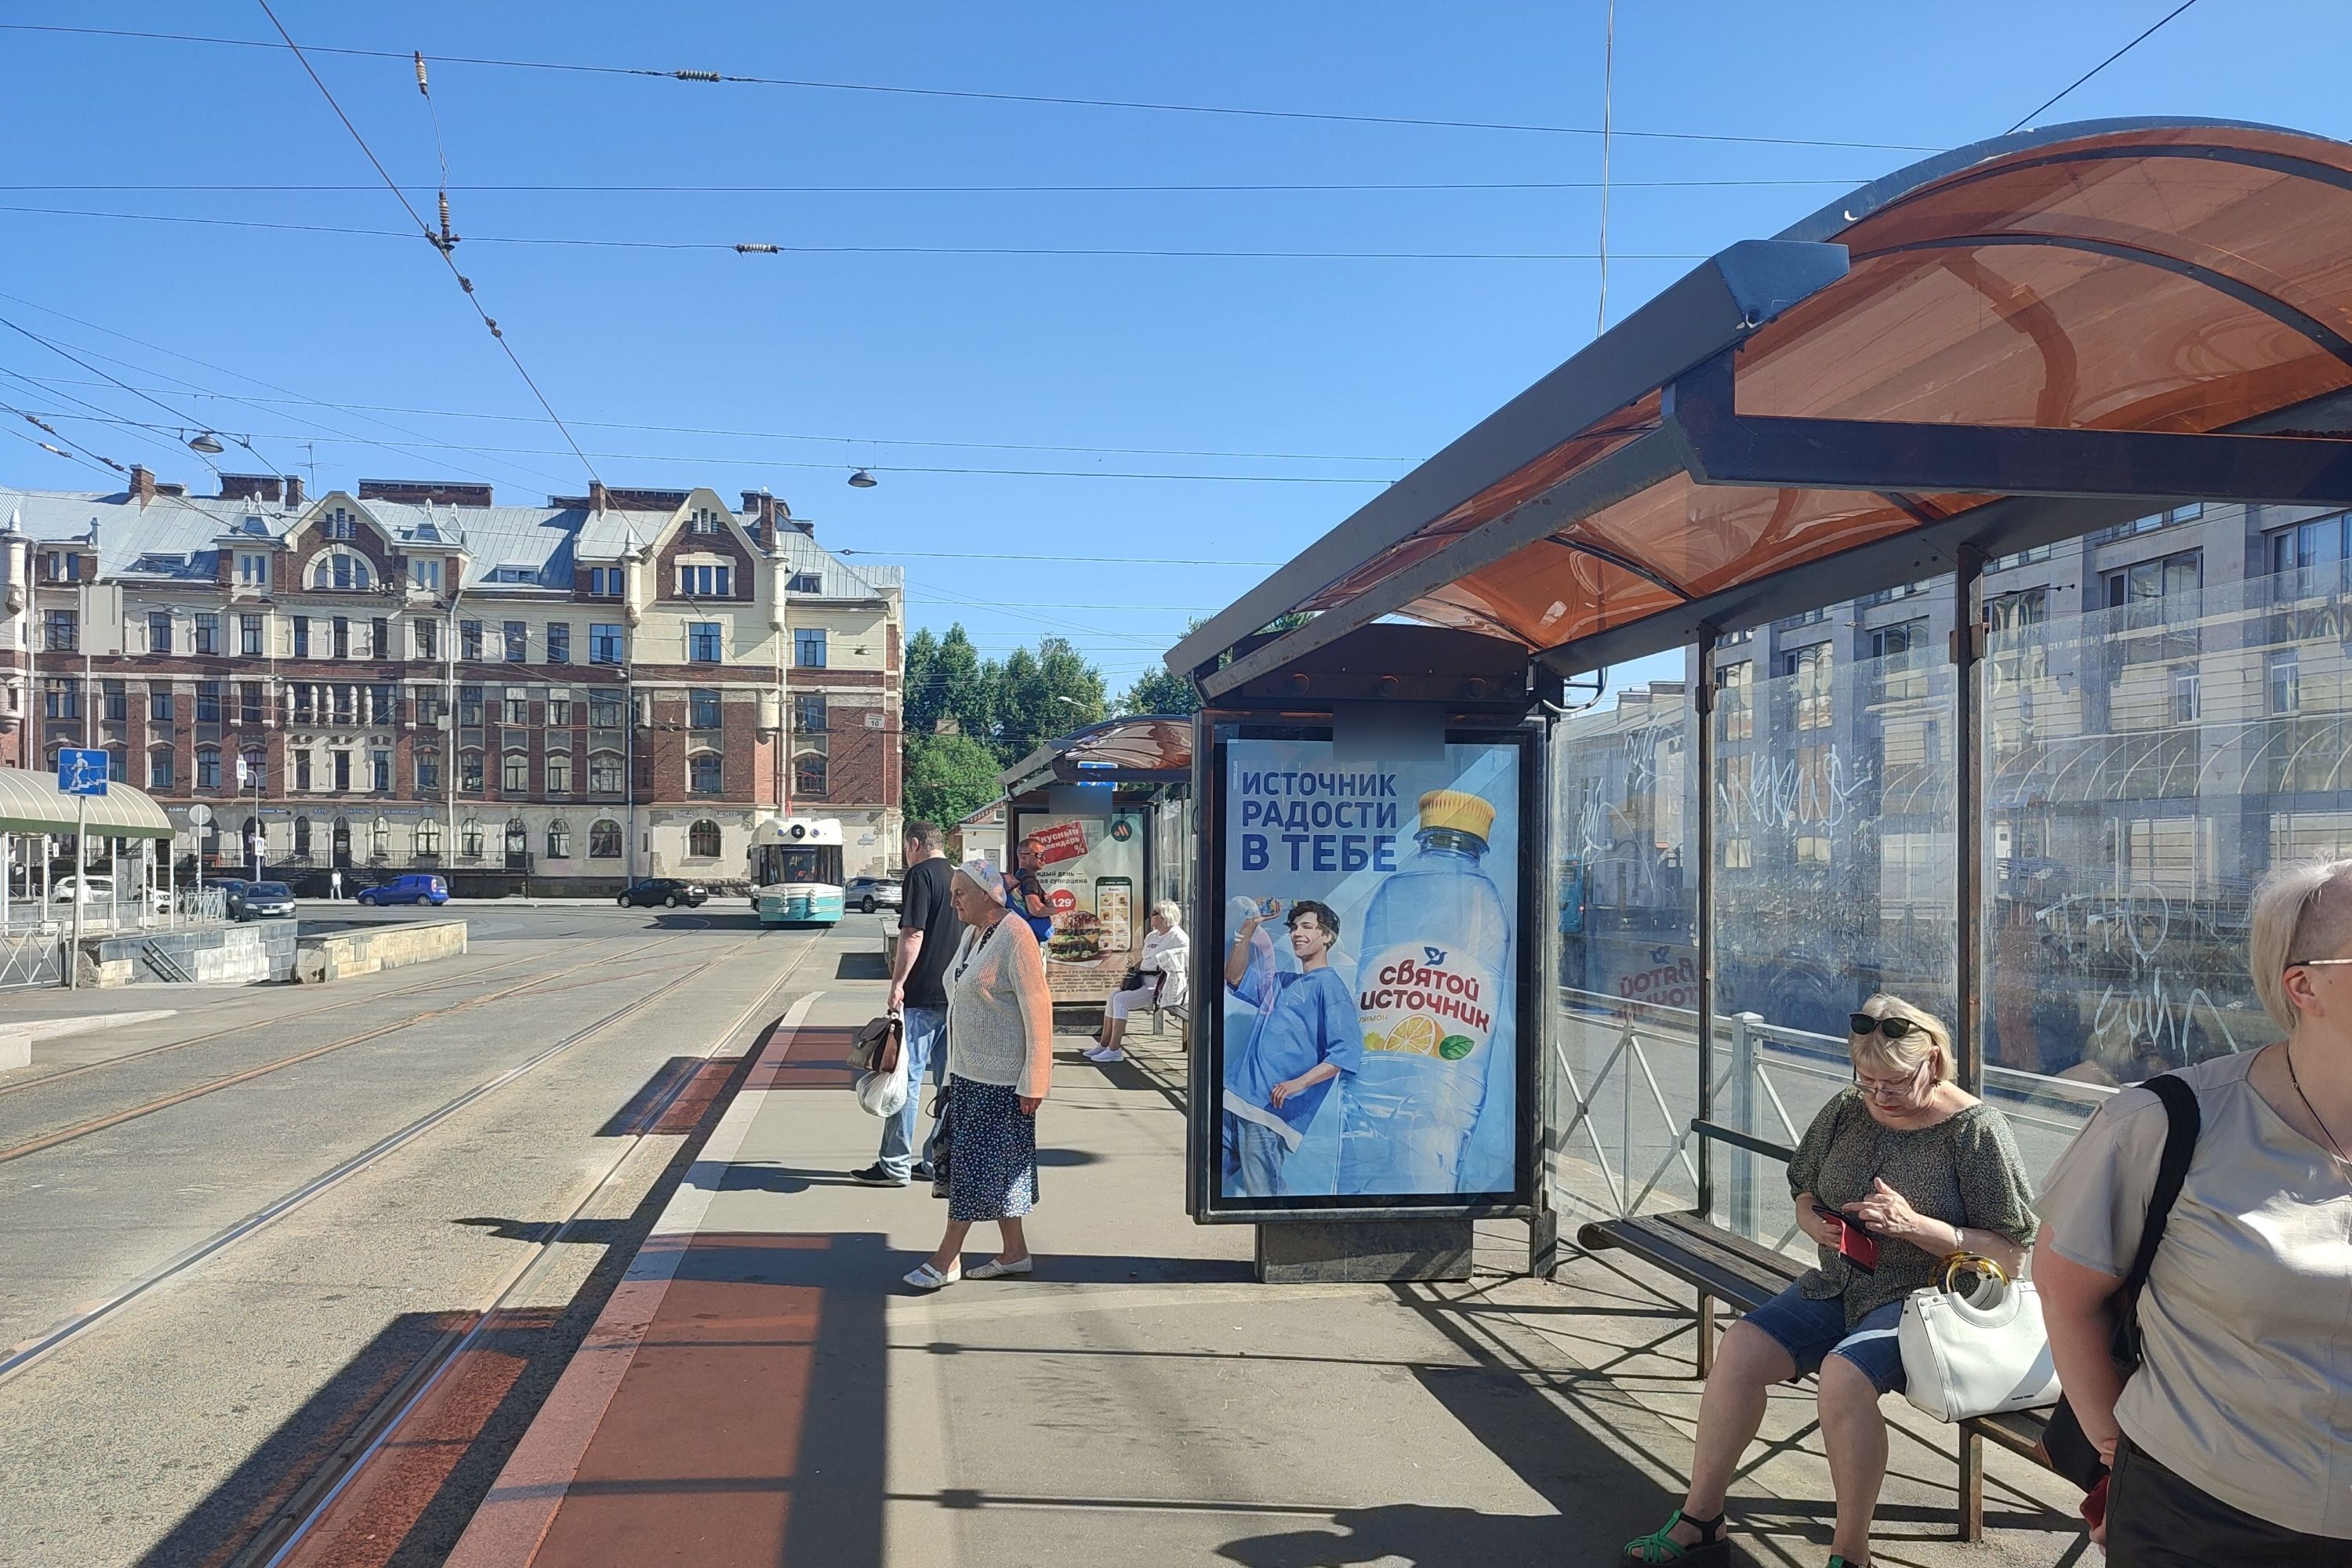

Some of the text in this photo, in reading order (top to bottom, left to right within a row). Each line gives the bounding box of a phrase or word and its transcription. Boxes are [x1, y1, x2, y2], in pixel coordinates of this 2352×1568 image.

[1243, 772, 1397, 796] ИСТОЧНИК
[1243, 800, 1396, 832] РАДОСТИ
[1041, 837, 1080, 851] алендарь
[1243, 834, 1396, 871] В ТЕБЕ
